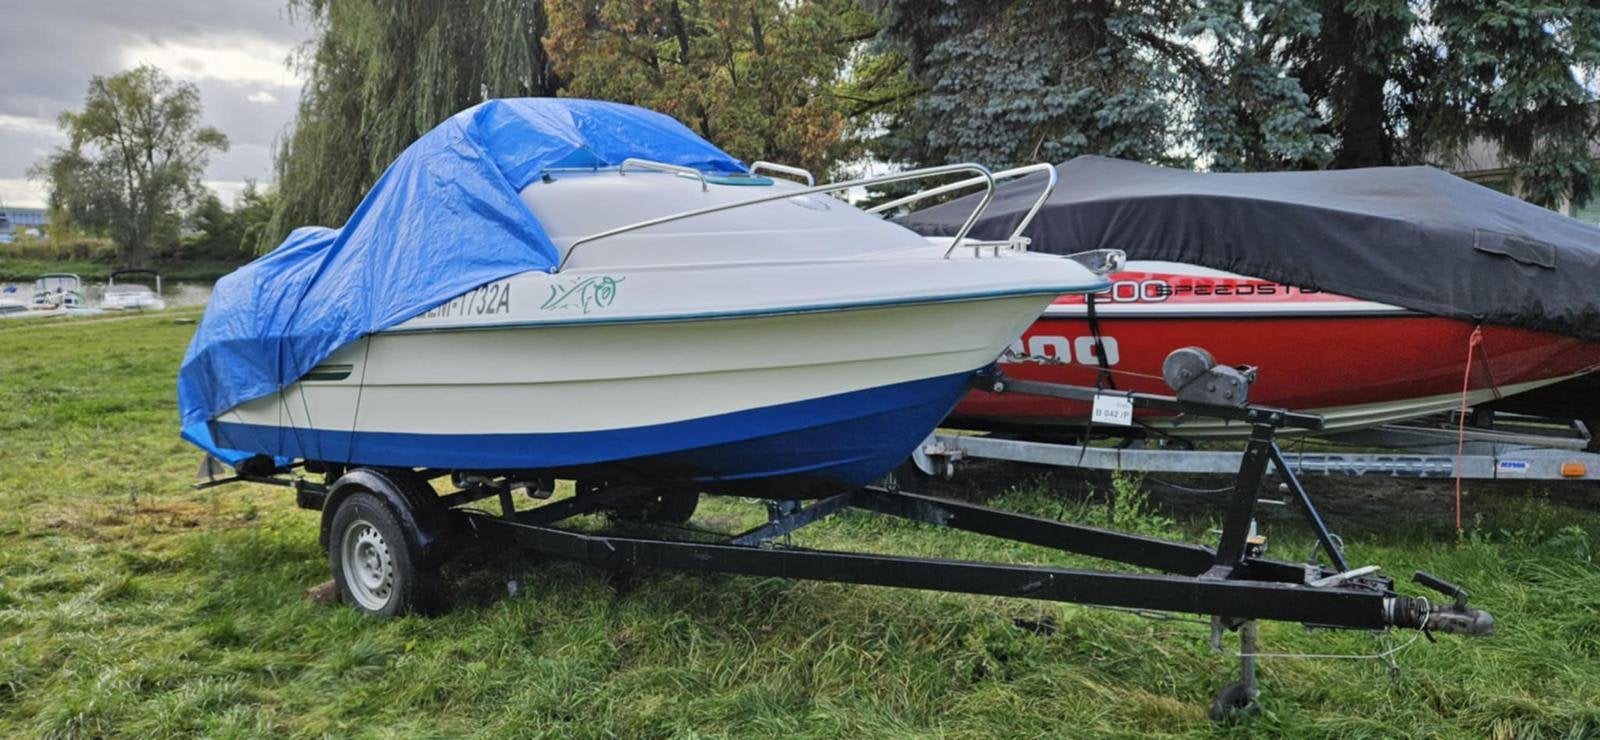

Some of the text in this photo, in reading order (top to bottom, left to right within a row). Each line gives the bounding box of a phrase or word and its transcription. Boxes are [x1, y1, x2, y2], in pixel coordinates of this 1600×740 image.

[416, 283, 510, 318] -1732A
[1155, 284, 1325, 296] SPEEDST
[997, 335, 1120, 365] 00
